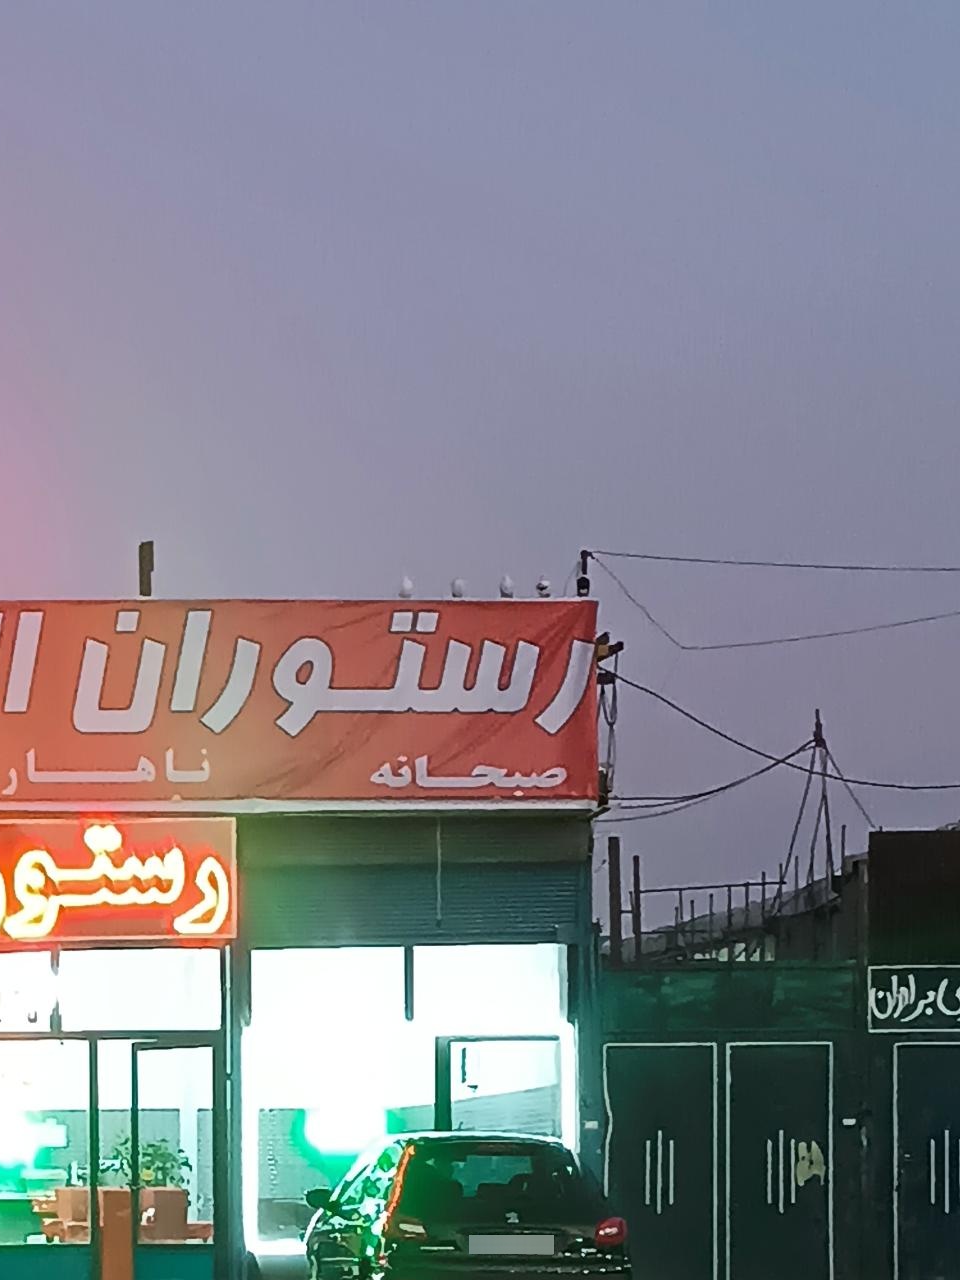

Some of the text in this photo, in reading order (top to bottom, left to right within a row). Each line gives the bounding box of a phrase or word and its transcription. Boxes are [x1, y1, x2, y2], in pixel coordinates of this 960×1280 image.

[72, 609, 595, 737] رستوران
[1, 747, 211, 796] ناهار
[369, 754, 568, 797] صبحانه
